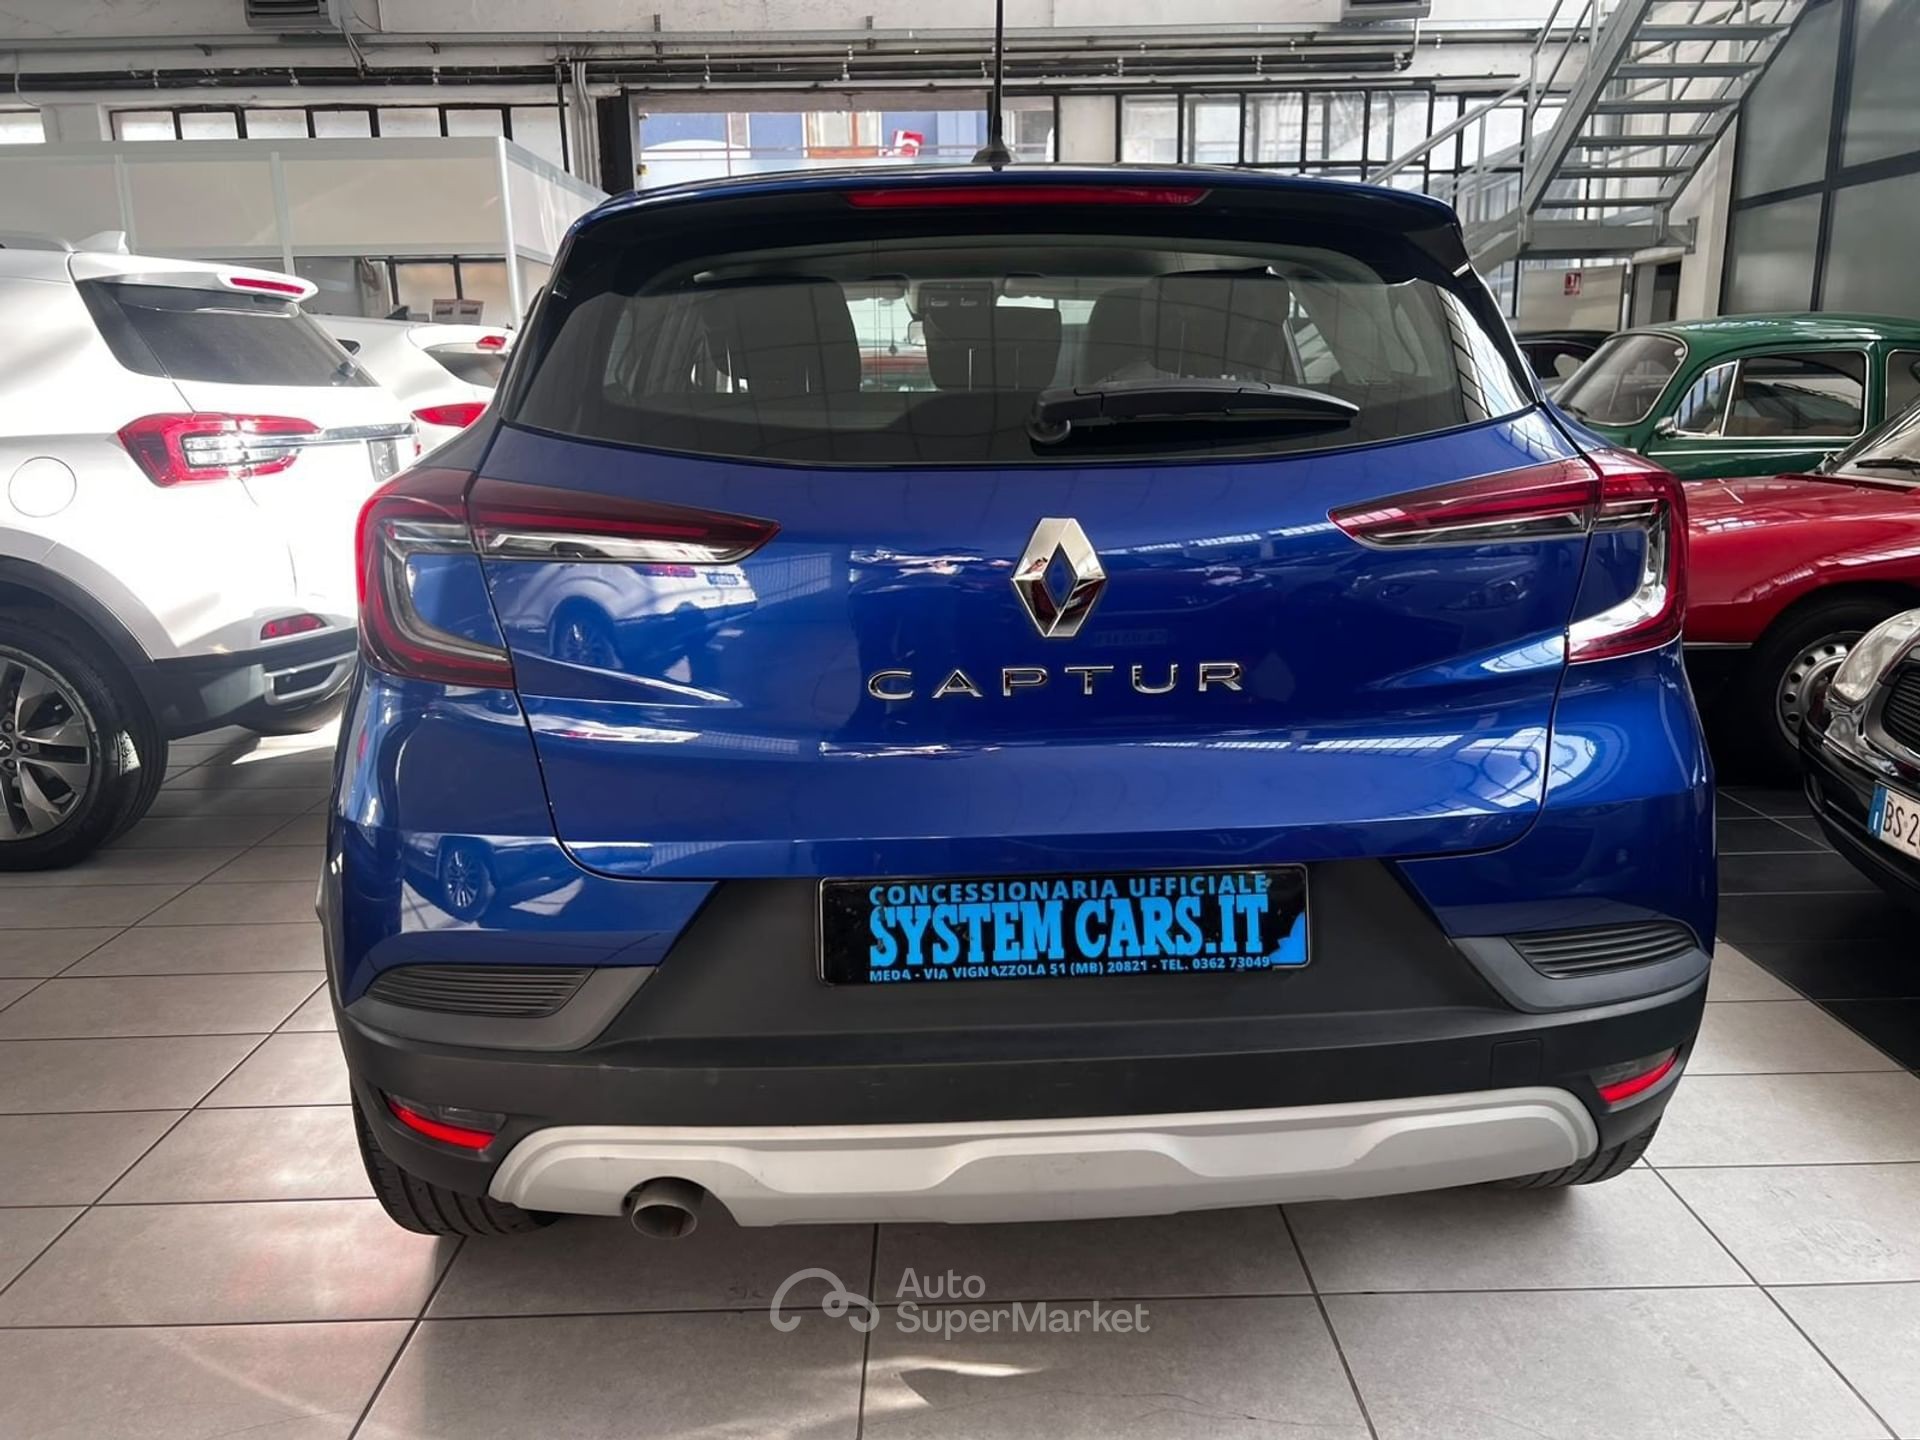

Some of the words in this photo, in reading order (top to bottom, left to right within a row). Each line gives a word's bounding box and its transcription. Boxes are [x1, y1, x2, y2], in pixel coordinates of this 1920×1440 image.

[867, 661, 1244, 700] CAPTUR
[1883, 801, 1904, 838] BS
[1906, 812, 1920, 847] 2
[869, 881, 1118, 905] CONCESSIONARIA
[1129, 875, 1267, 897] UFFICIALE
[869, 900, 1065, 967] SYSTEM
[1075, 894, 1269, 958] CARS.IT
[869, 969, 911, 983] MEDA
[924, 968, 948, 980] VIA
[953, 963, 1046, 978] VIGNAZZOLA
[1050, 962, 1066, 976] 51
[1070, 961, 1104, 976] (MB)
[1107, 959, 1148, 973] 20821
[1160, 958, 1189, 972] TEL.
[1192, 955, 1226, 970] 0362
[1229, 955, 1270, 969] 73049
